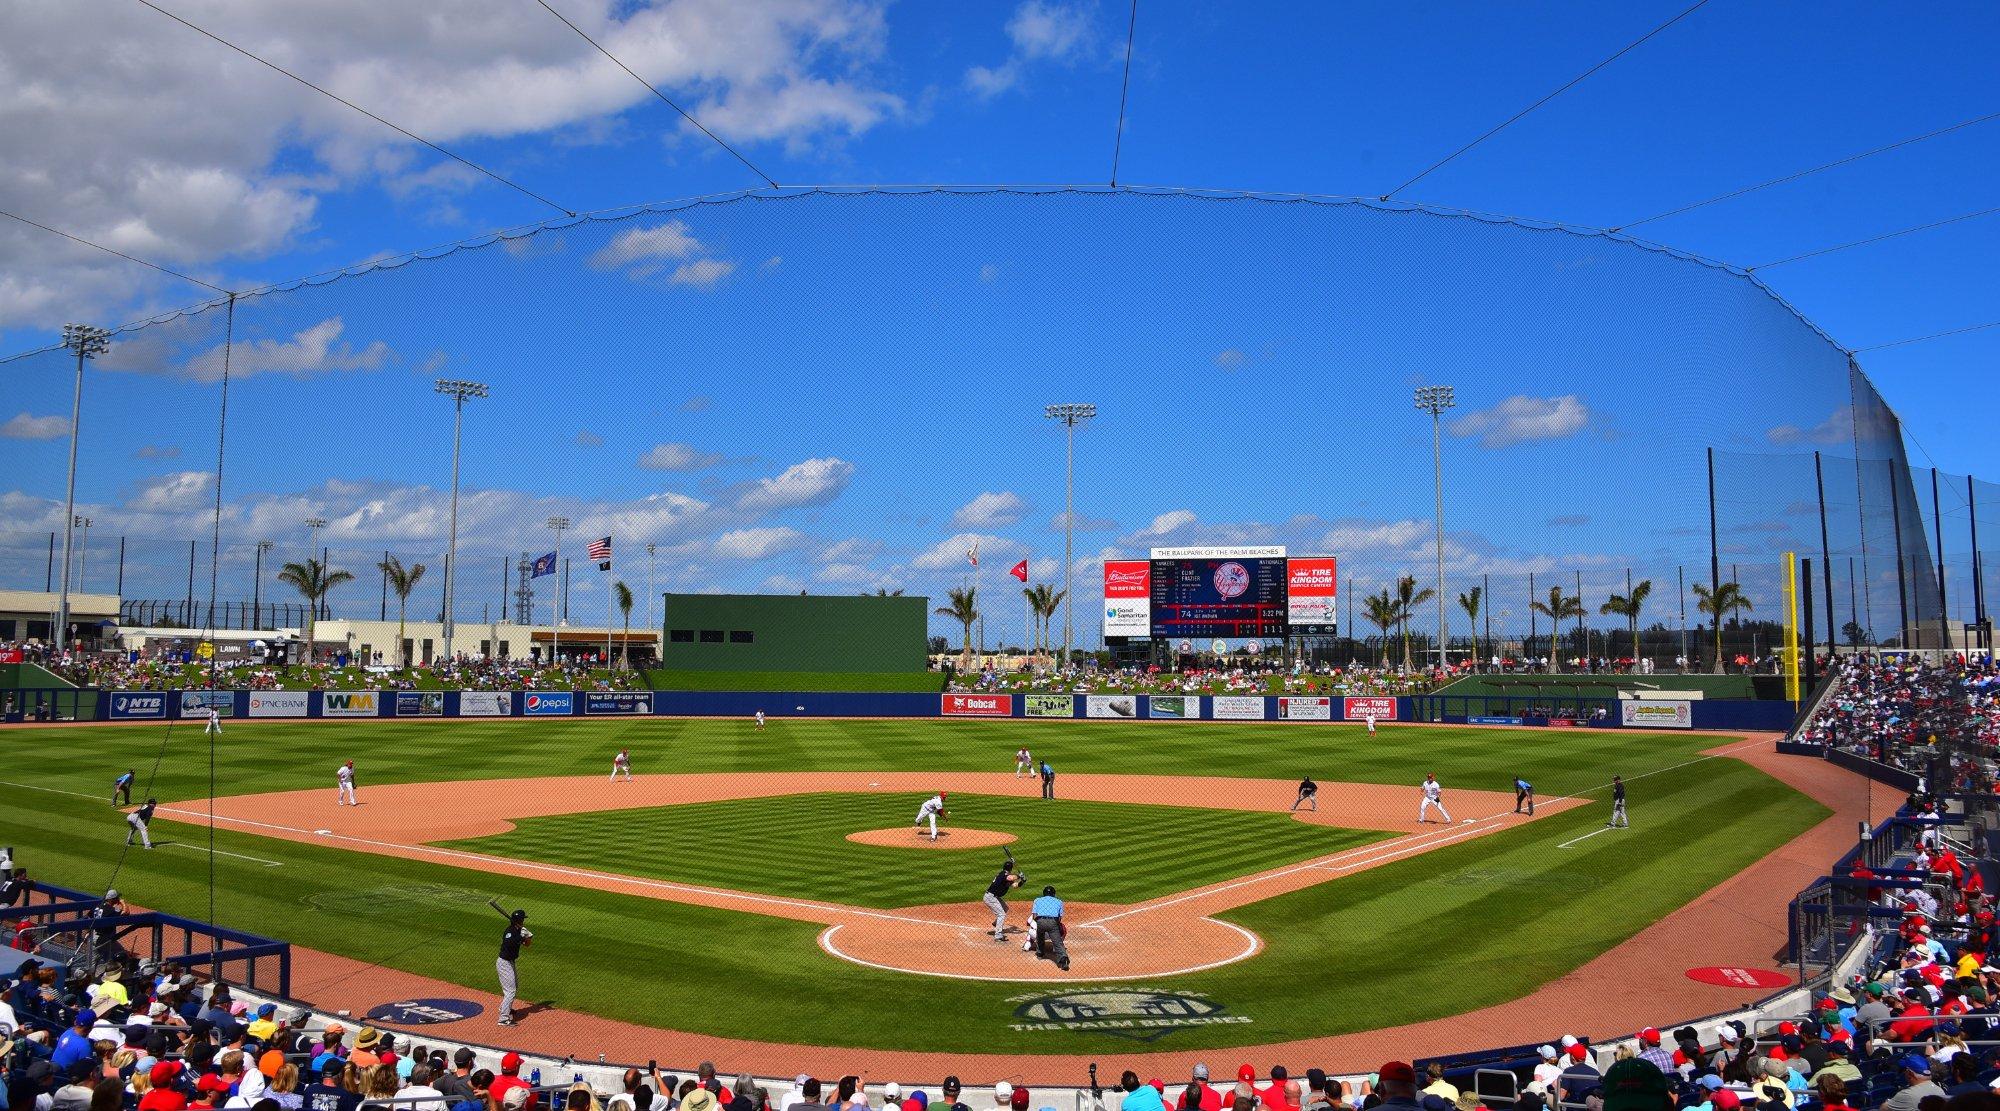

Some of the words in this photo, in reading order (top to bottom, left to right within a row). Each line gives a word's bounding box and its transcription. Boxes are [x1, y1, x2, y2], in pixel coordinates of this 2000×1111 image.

[1110, 573, 1144, 581] Budweiser
[1181, 610, 1192, 618] 74
[220, 645, 240, 653] LAWN
[130, 698, 161, 707] NTB
[327, 694, 373, 709] WM
[542, 698, 569, 709] pepsi
[967, 698, 996, 709] Bobcat
[1009, 1023, 1061, 1031] THE
[1068, 1019, 1133, 1029] PALM
[1139, 1016, 1253, 1027] BEACHES
